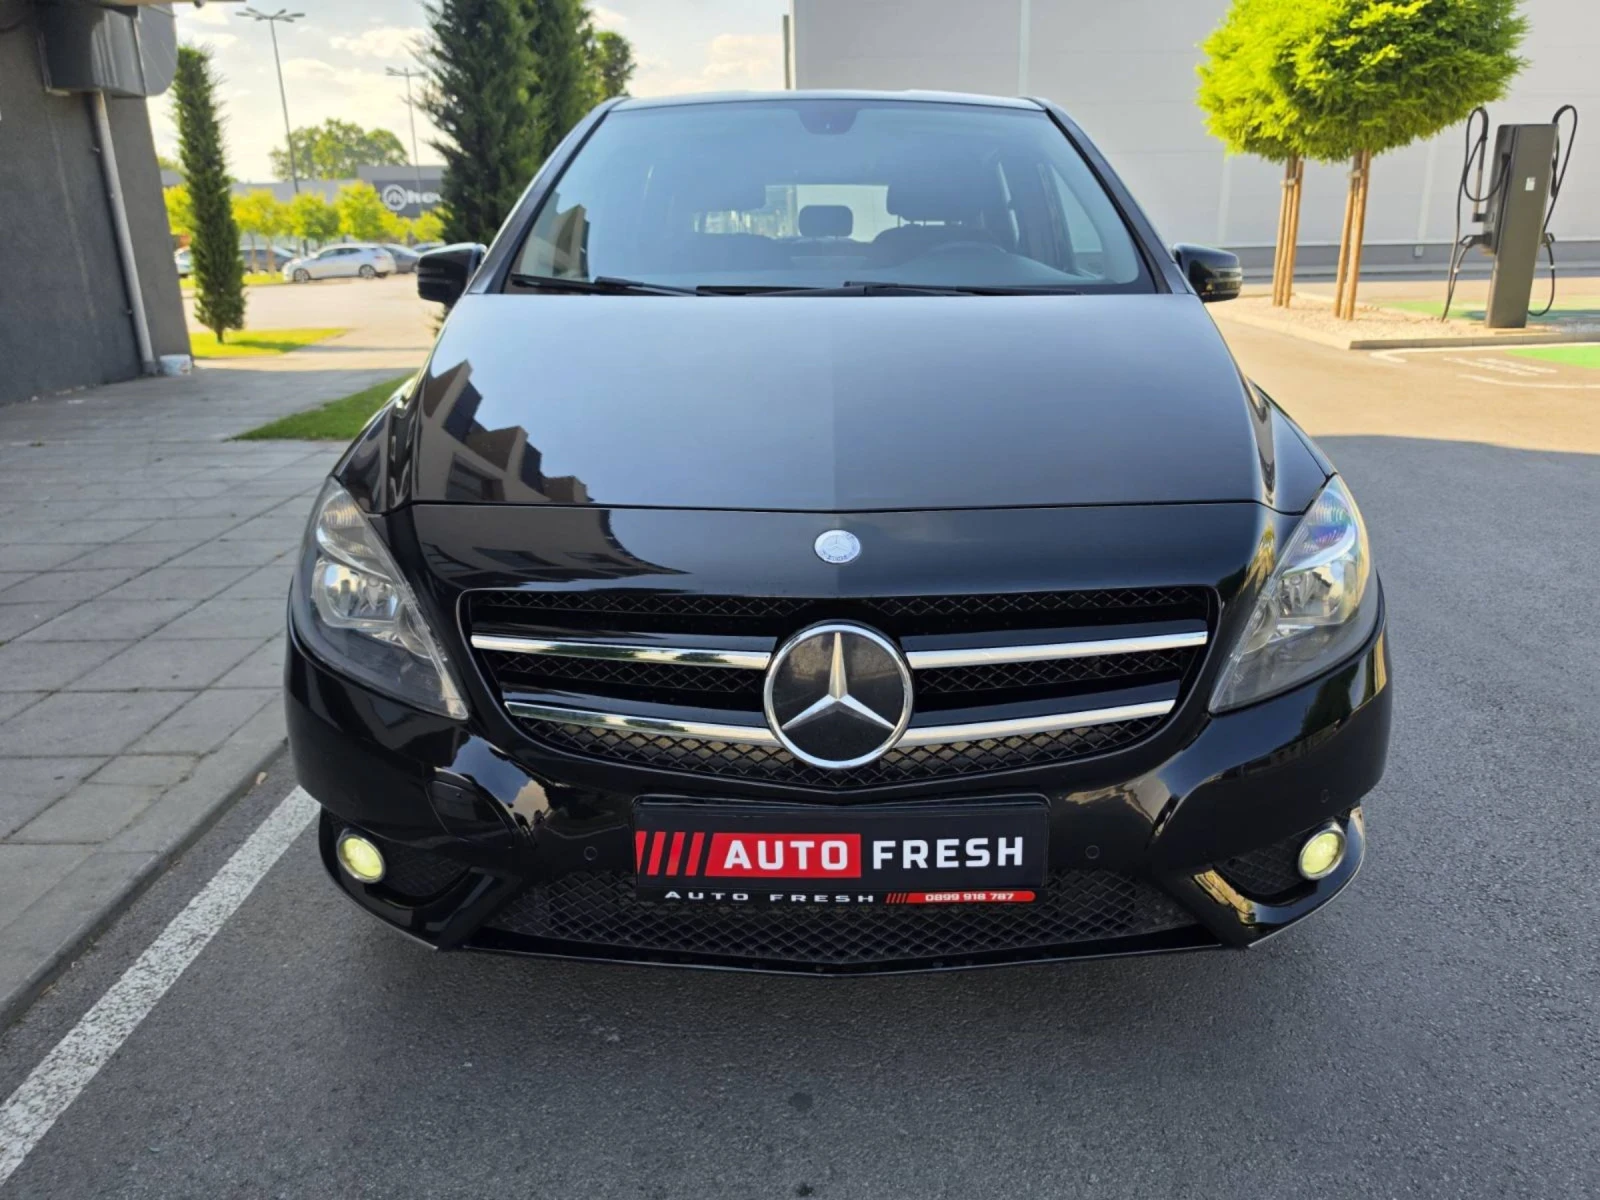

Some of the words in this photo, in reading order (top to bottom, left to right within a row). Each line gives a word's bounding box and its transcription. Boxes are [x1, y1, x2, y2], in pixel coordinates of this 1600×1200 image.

[723, 840, 848, 870] AUTO
[872, 837, 1023, 870] FRESH
[664, 891, 749, 901] AUTO
[769, 893, 874, 903] FRESH
[925, 893, 960, 902] 0899
[990, 891, 1015, 900] 787
